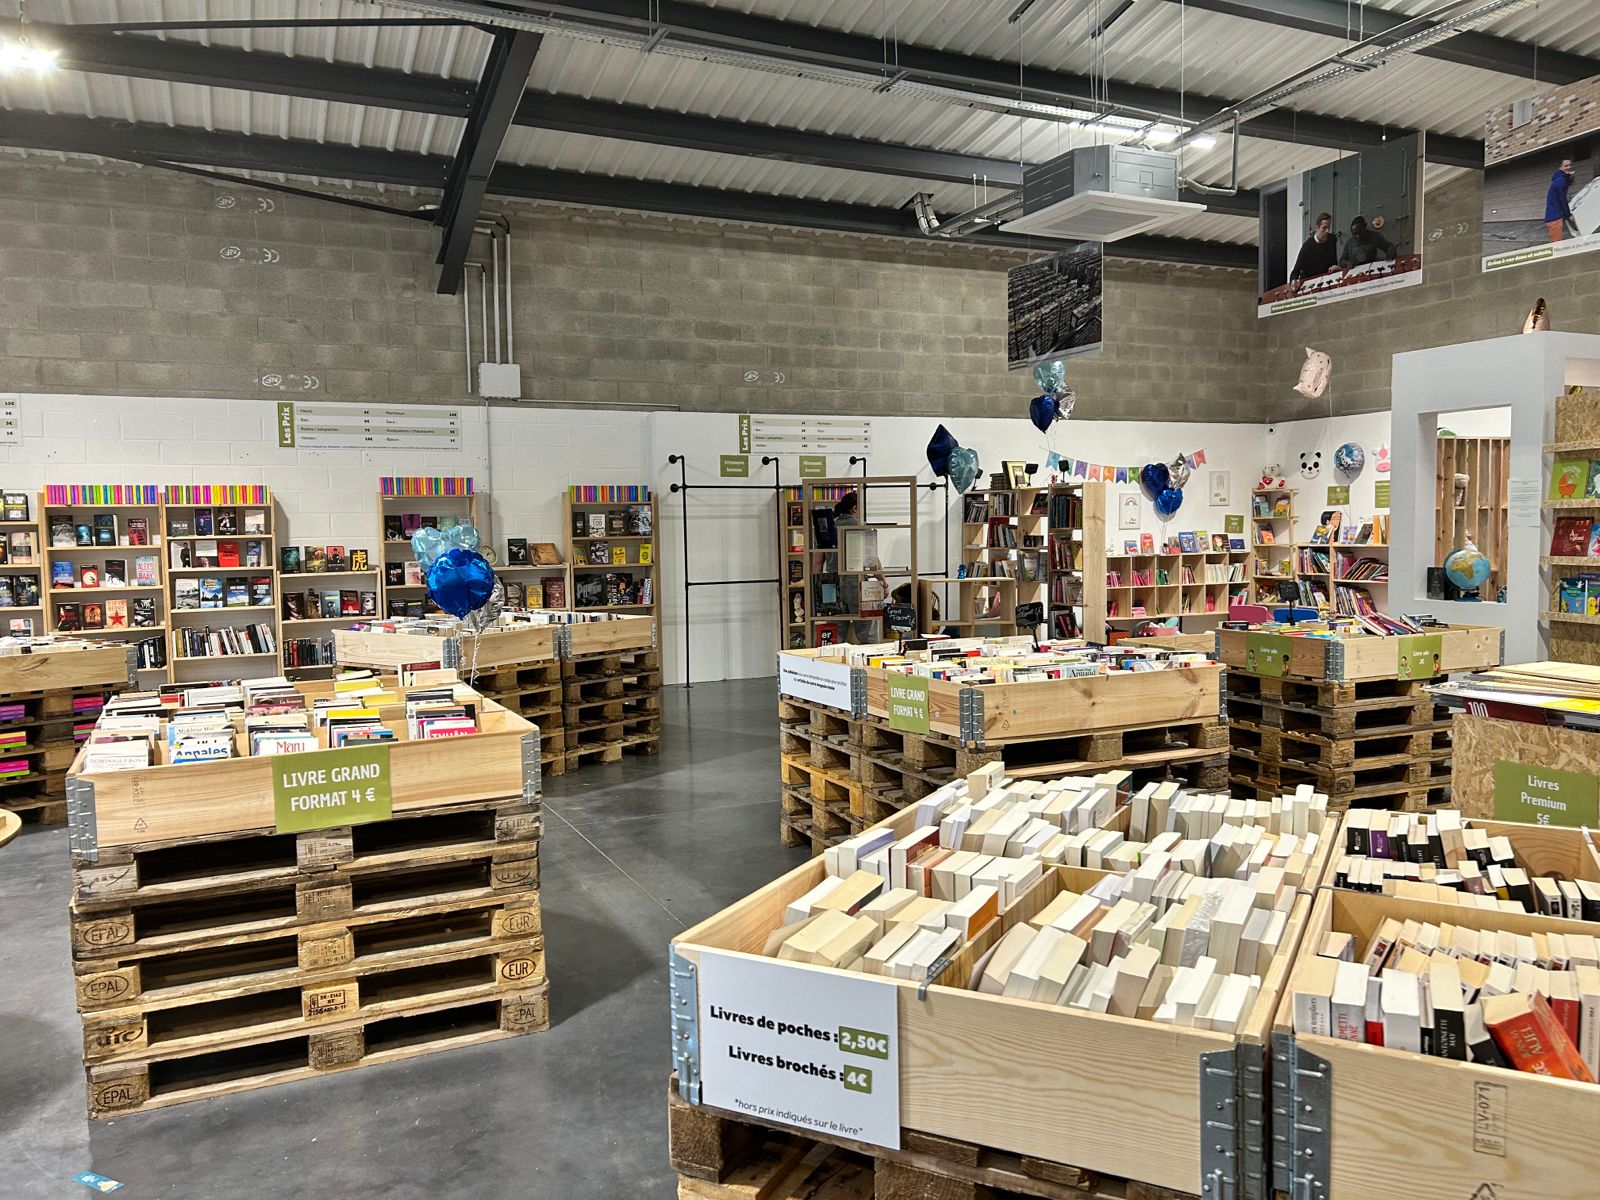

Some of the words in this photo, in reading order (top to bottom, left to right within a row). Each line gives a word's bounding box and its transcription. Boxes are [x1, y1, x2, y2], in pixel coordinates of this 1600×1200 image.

[282, 406, 291, 427] Prix
[741, 418, 749, 436] Prix
[282, 428, 292, 444] Les
[741, 436, 749, 451] Les
[351, 550, 368, 571] 虎
[890, 687, 906, 699] LIVRE
[906, 688, 926, 702] GRAND
[893, 705, 914, 718] FORMAT
[914, 709, 920, 718] 4
[920, 709, 925, 720] €
[1468, 700, 1489, 718] 100
[176, 747, 228, 758] Annales
[282, 770, 327, 788] LIVRE
[331, 763, 381, 784] GRAND
[1528, 774, 1560, 791] Livres
[290, 790, 348, 812] FORMAT
[351, 789, 362, 802] 4
[365, 787, 376, 802] €
[1520, 791, 1567, 811] Premium
[1536, 813, 1551, 825] 5€
[509, 916, 530, 931] EUR
[90, 926, 123, 942] EPAL
[508, 962, 529, 977] EUR
[90, 980, 123, 997] EPAL
[710, 1004, 754, 1026] Livres
[756, 1015, 775, 1030] de
[777, 1021, 831, 1042] poches
[840, 1031, 887, 1053] 2,50€
[728, 1045, 774, 1066] Livres
[776, 1056, 837, 1080] brochés
[846, 1071, 868, 1088] 4€
[103, 1088, 135, 1105] EPAL
[758, 1106, 775, 1117] prix
[776, 1109, 813, 1126] indiqués
[814, 1118, 828, 1128] sur
[830, 1120, 838, 1130] le
